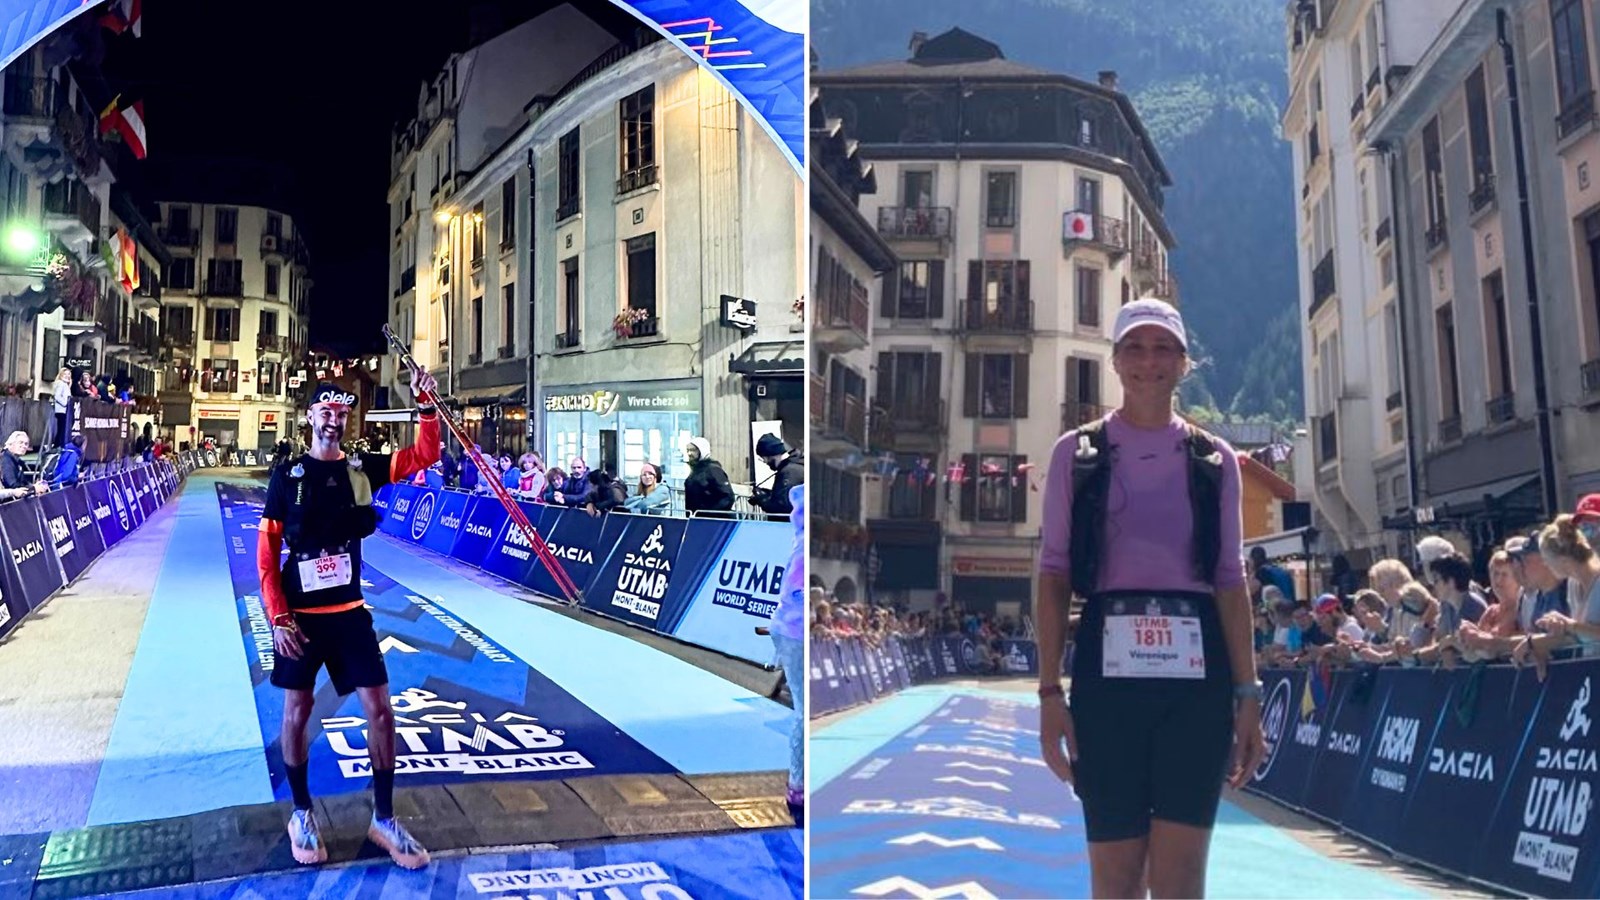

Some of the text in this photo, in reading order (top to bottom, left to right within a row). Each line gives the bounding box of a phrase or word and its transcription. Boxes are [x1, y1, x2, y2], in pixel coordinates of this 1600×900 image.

[627, 395, 689, 406] Vivre chez soi
[466, 523, 492, 538] DACIA
[12, 540, 43, 564] DACIA
[542, 542, 593, 564] DACIA
[624, 553, 671, 571] DACIA
[317, 562, 337, 573] 399
[716, 591, 776, 616] WORLD SERIES
[1135, 629, 1173, 646] 1811
[1328, 730, 1361, 755] DACIA
[1377, 716, 1420, 764] HOKA
[1429, 748, 1494, 781] DACIA
[1536, 747, 1598, 772] DACIA
